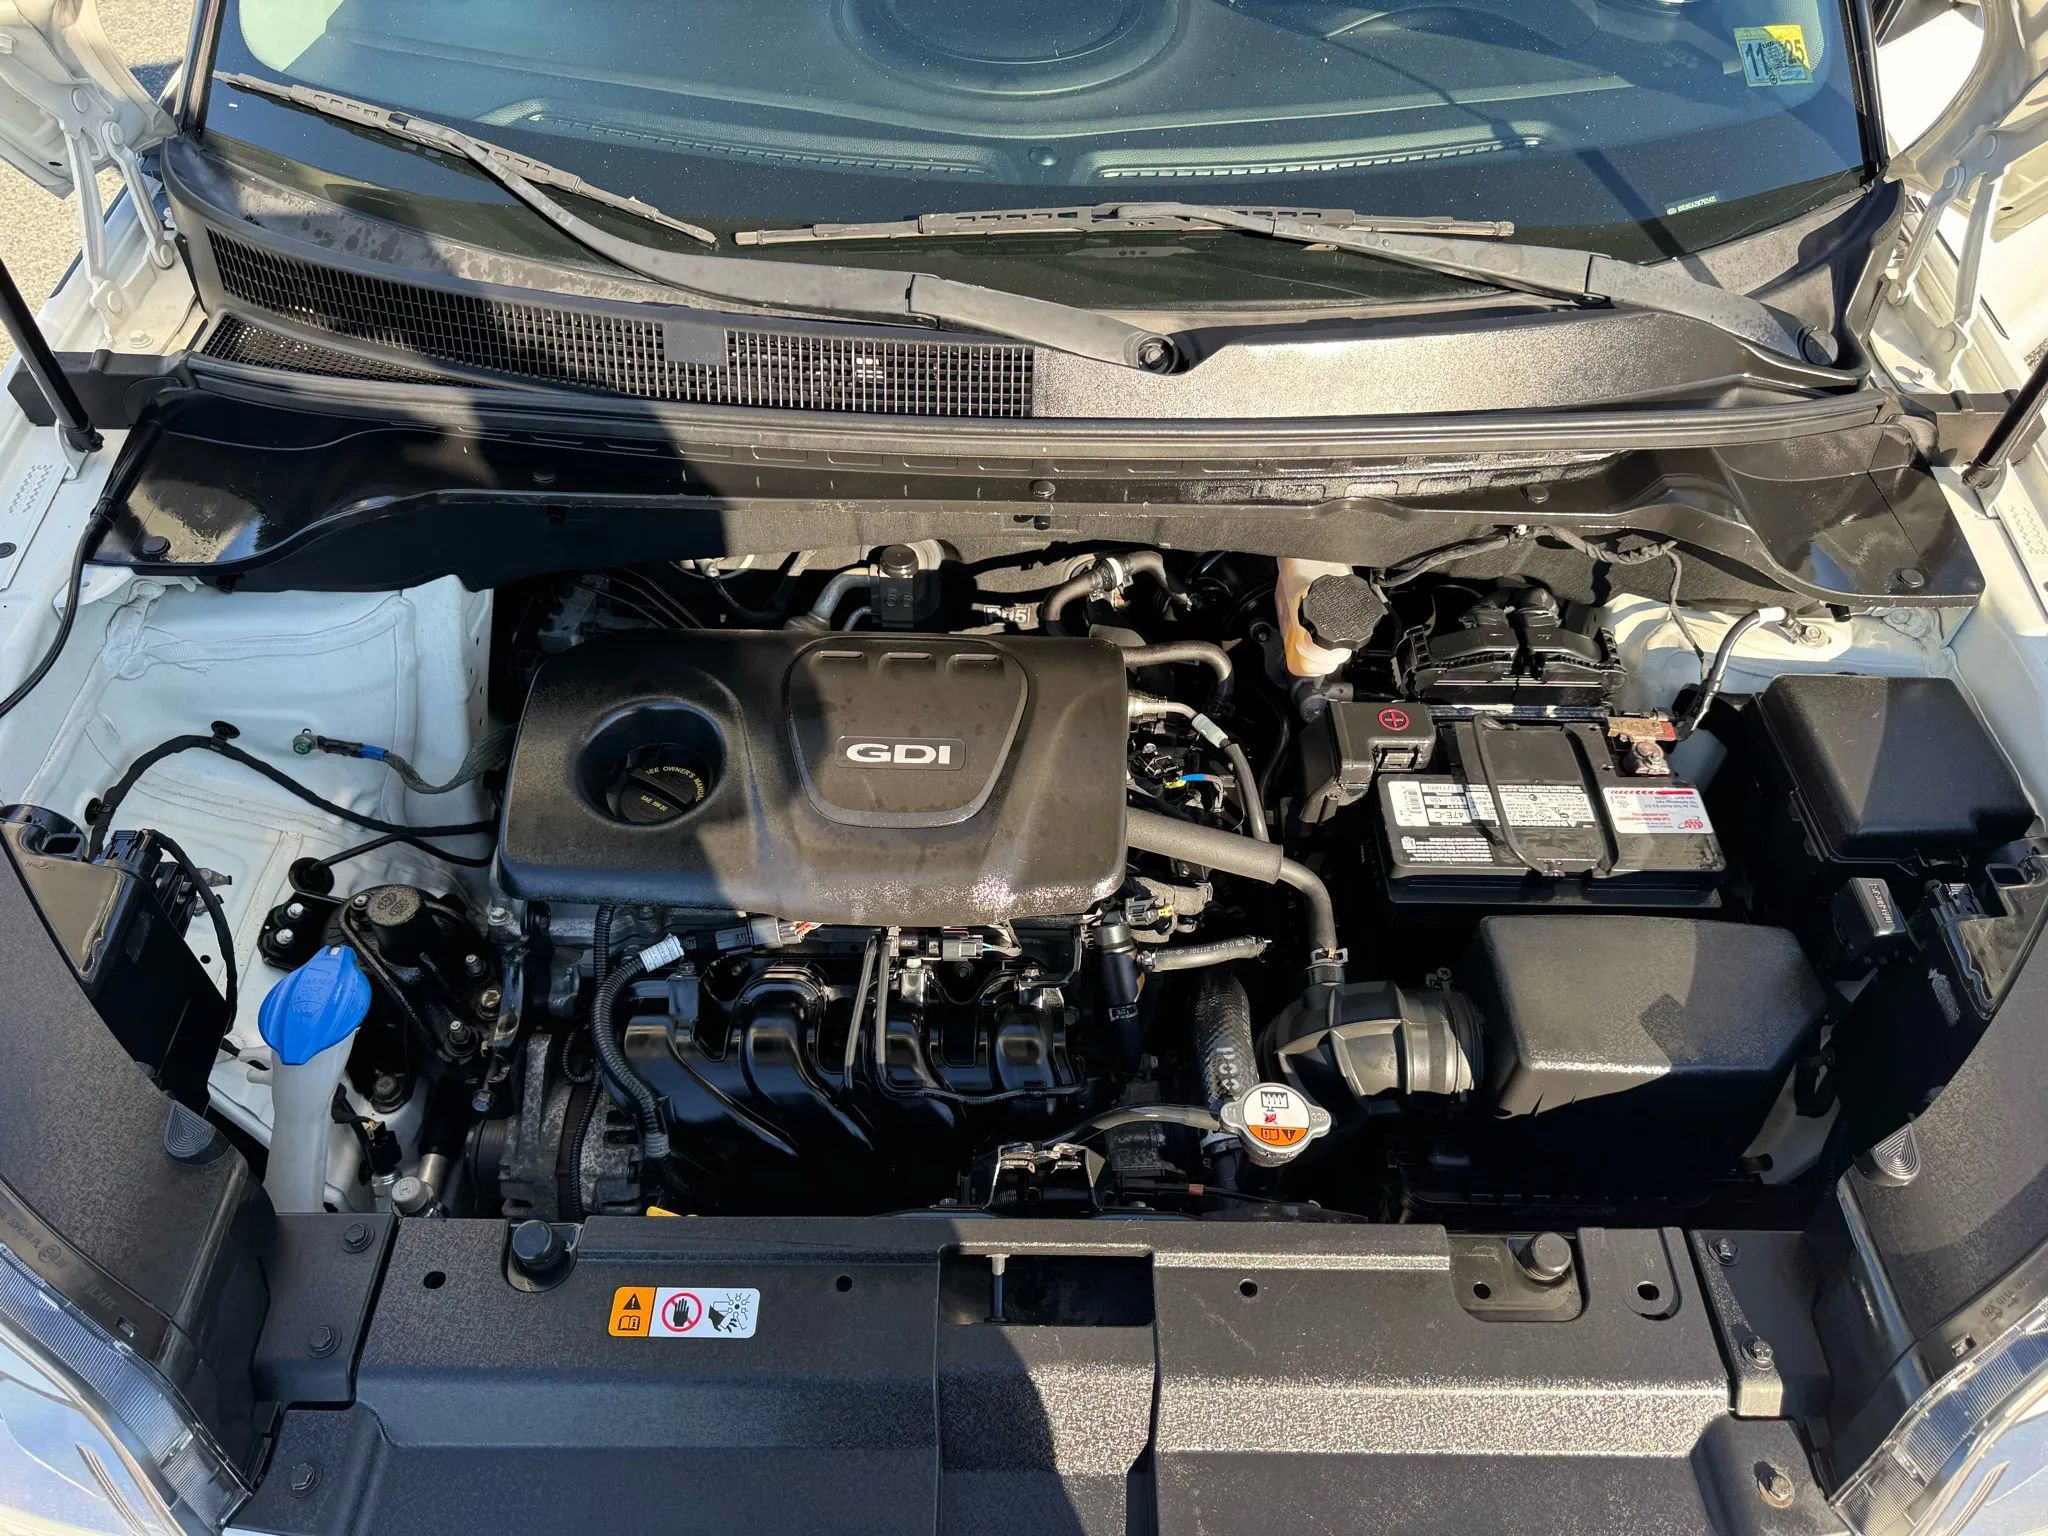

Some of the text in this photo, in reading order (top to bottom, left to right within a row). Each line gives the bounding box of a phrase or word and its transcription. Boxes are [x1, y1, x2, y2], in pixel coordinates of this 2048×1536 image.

[1745, 43, 1769, 77] 11
[1785, 39, 1805, 66] 25
[846, 743, 951, 765] GDI
[662, 766, 696, 778] OWNER'S
[641, 795, 653, 804] SAE
